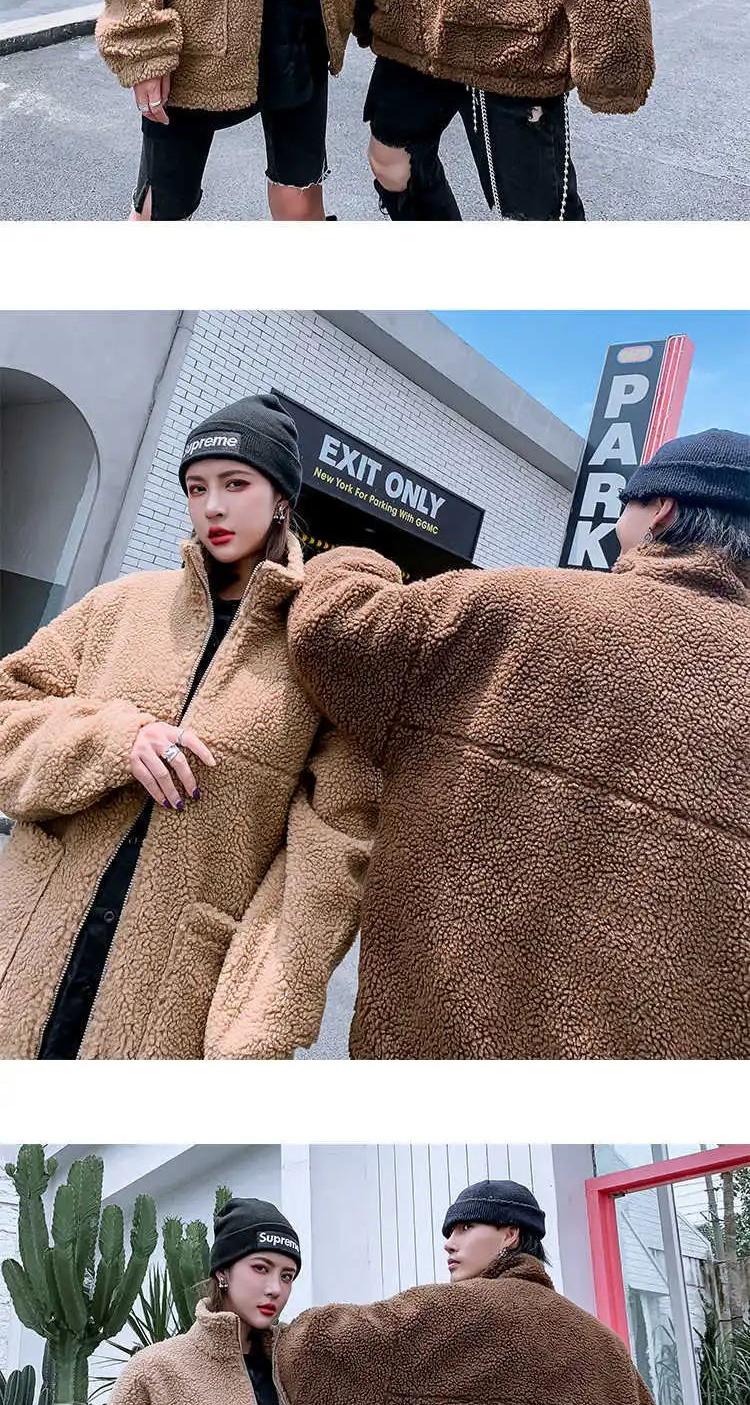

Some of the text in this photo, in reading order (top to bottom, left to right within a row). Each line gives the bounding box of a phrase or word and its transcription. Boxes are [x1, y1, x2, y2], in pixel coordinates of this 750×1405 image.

[313, 467, 439, 535] New York For Parking With GGMC
[318, 434, 446, 519] EXIT ONLY
[567, 374, 650, 570] PARK
